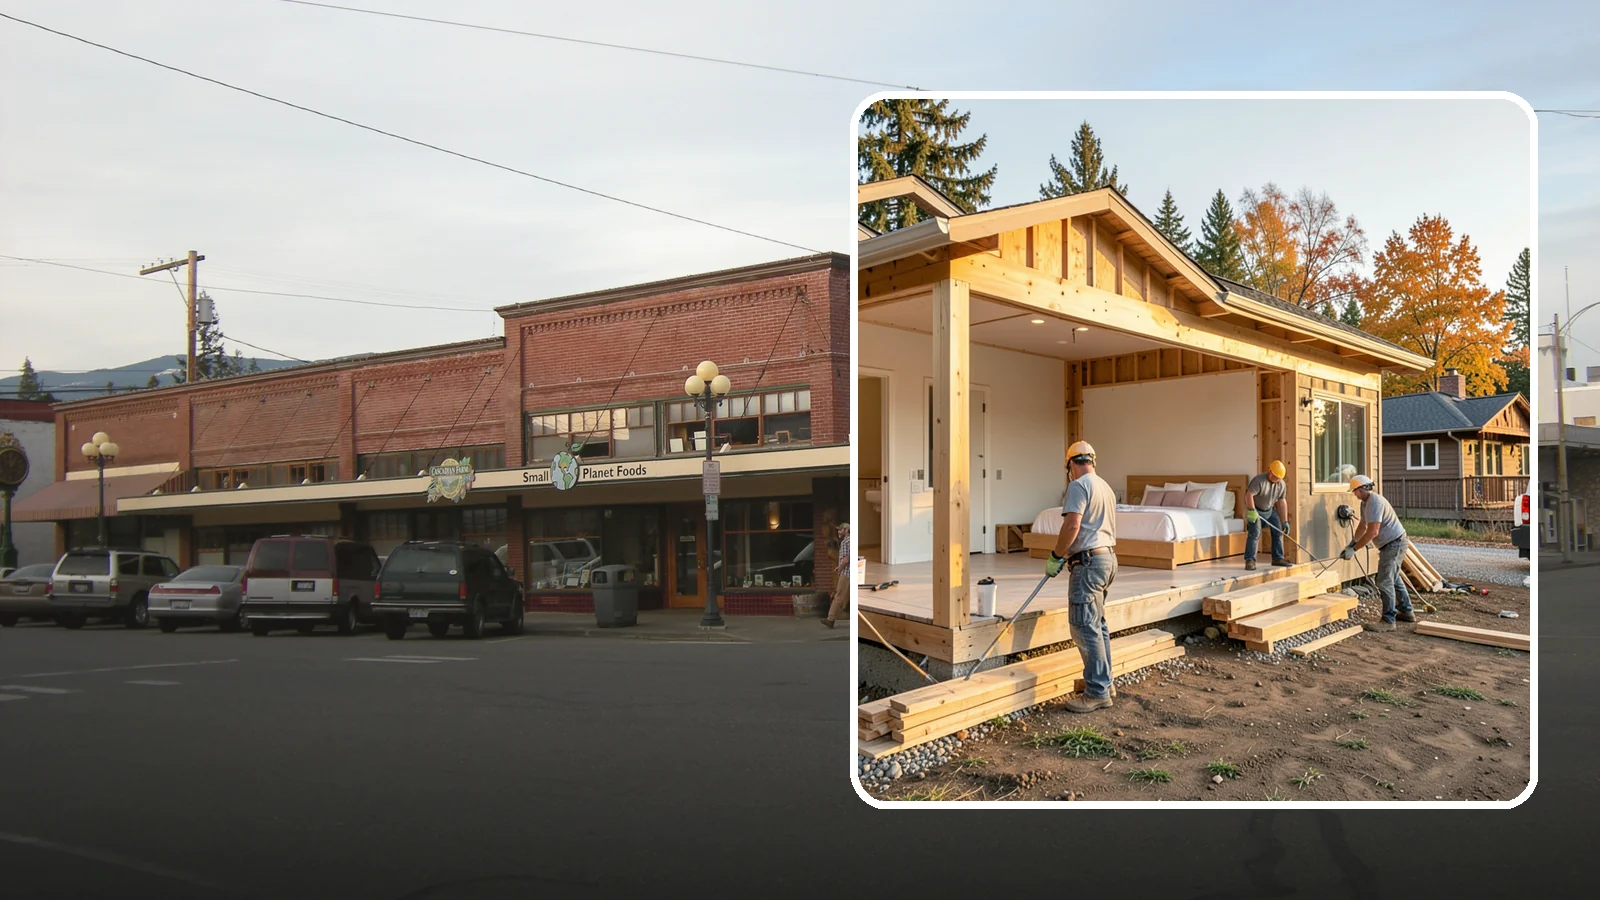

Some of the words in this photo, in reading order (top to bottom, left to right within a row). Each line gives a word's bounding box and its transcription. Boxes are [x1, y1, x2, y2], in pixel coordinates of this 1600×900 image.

[523, 470, 549, 483] Small
[583, 467, 614, 480] Planet
[617, 464, 647, 477] Foods
